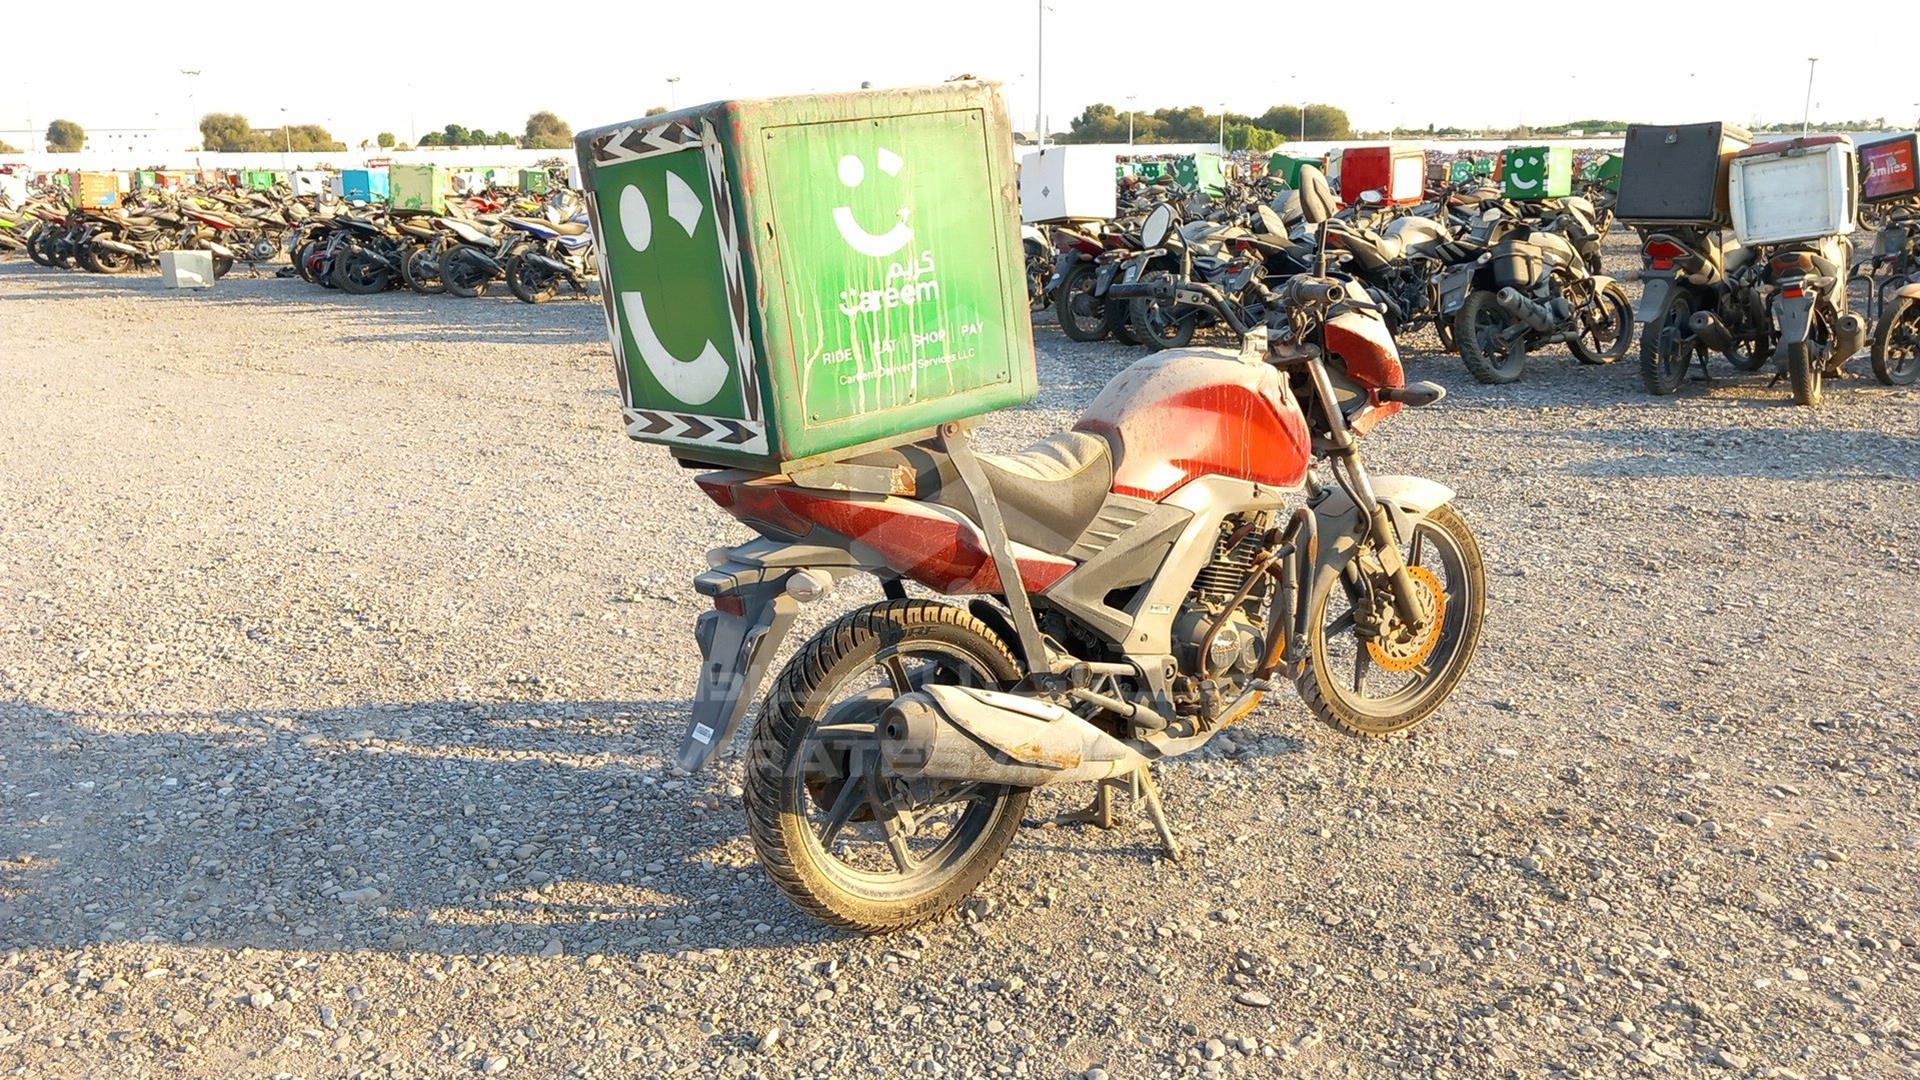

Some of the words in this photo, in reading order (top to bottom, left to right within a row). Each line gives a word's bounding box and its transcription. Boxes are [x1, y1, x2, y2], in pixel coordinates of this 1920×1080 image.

[822, 349, 852, 365] RIDE
[876, 338, 897, 355] EAT
[913, 330, 946, 347] SHOP
[961, 322, 984, 337] PAY
[879, 361, 916, 376] Deiver
[958, 348, 975, 360] LLC
